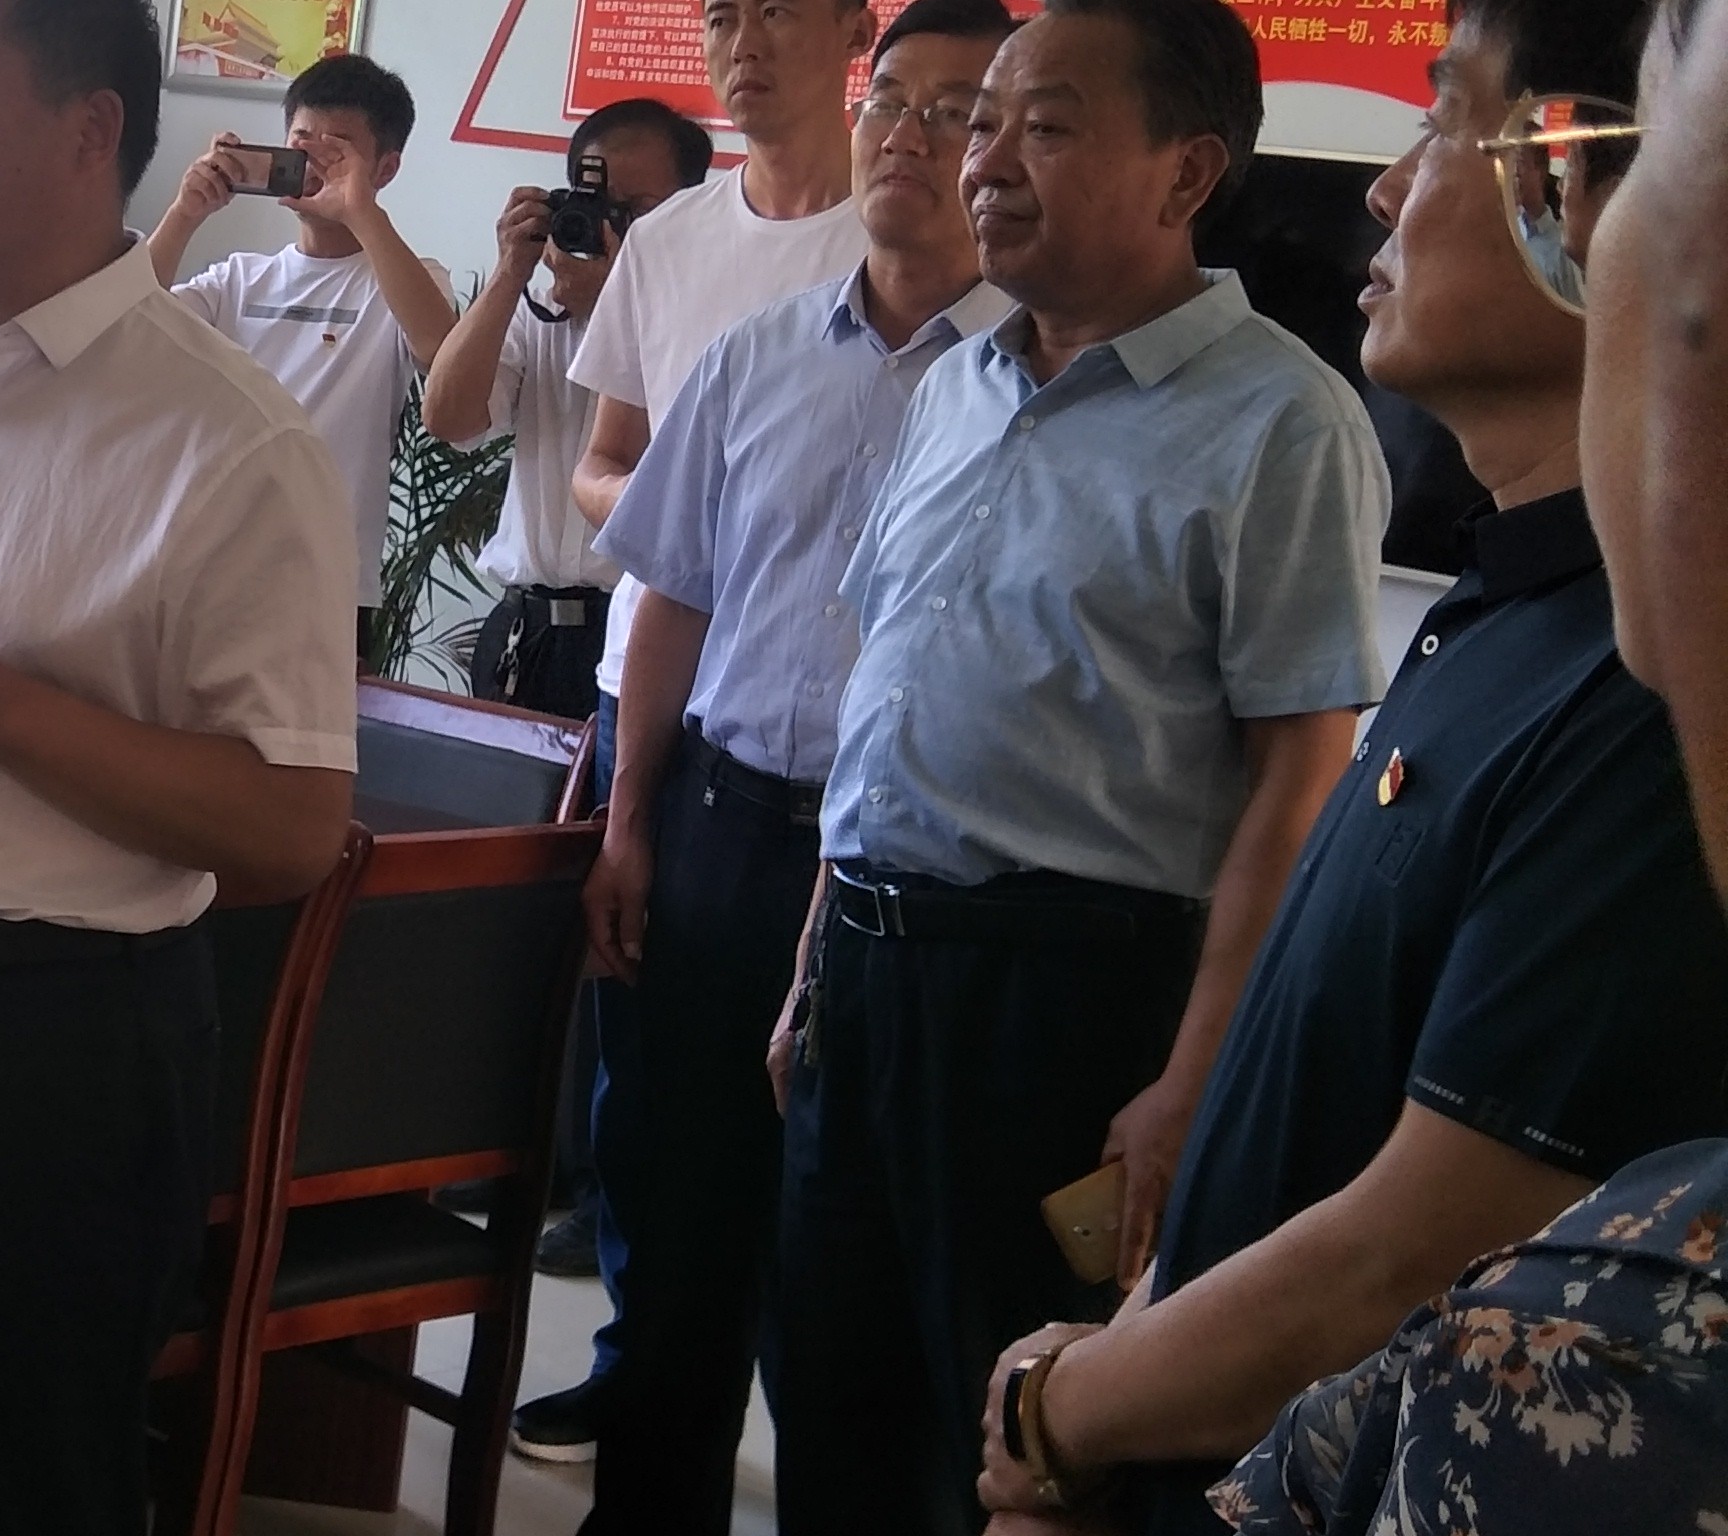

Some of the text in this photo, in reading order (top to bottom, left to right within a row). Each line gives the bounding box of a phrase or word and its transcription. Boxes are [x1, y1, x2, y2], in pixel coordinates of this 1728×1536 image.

[1243, 15, 1449, 47] 人民牺牲一切，永不叛
